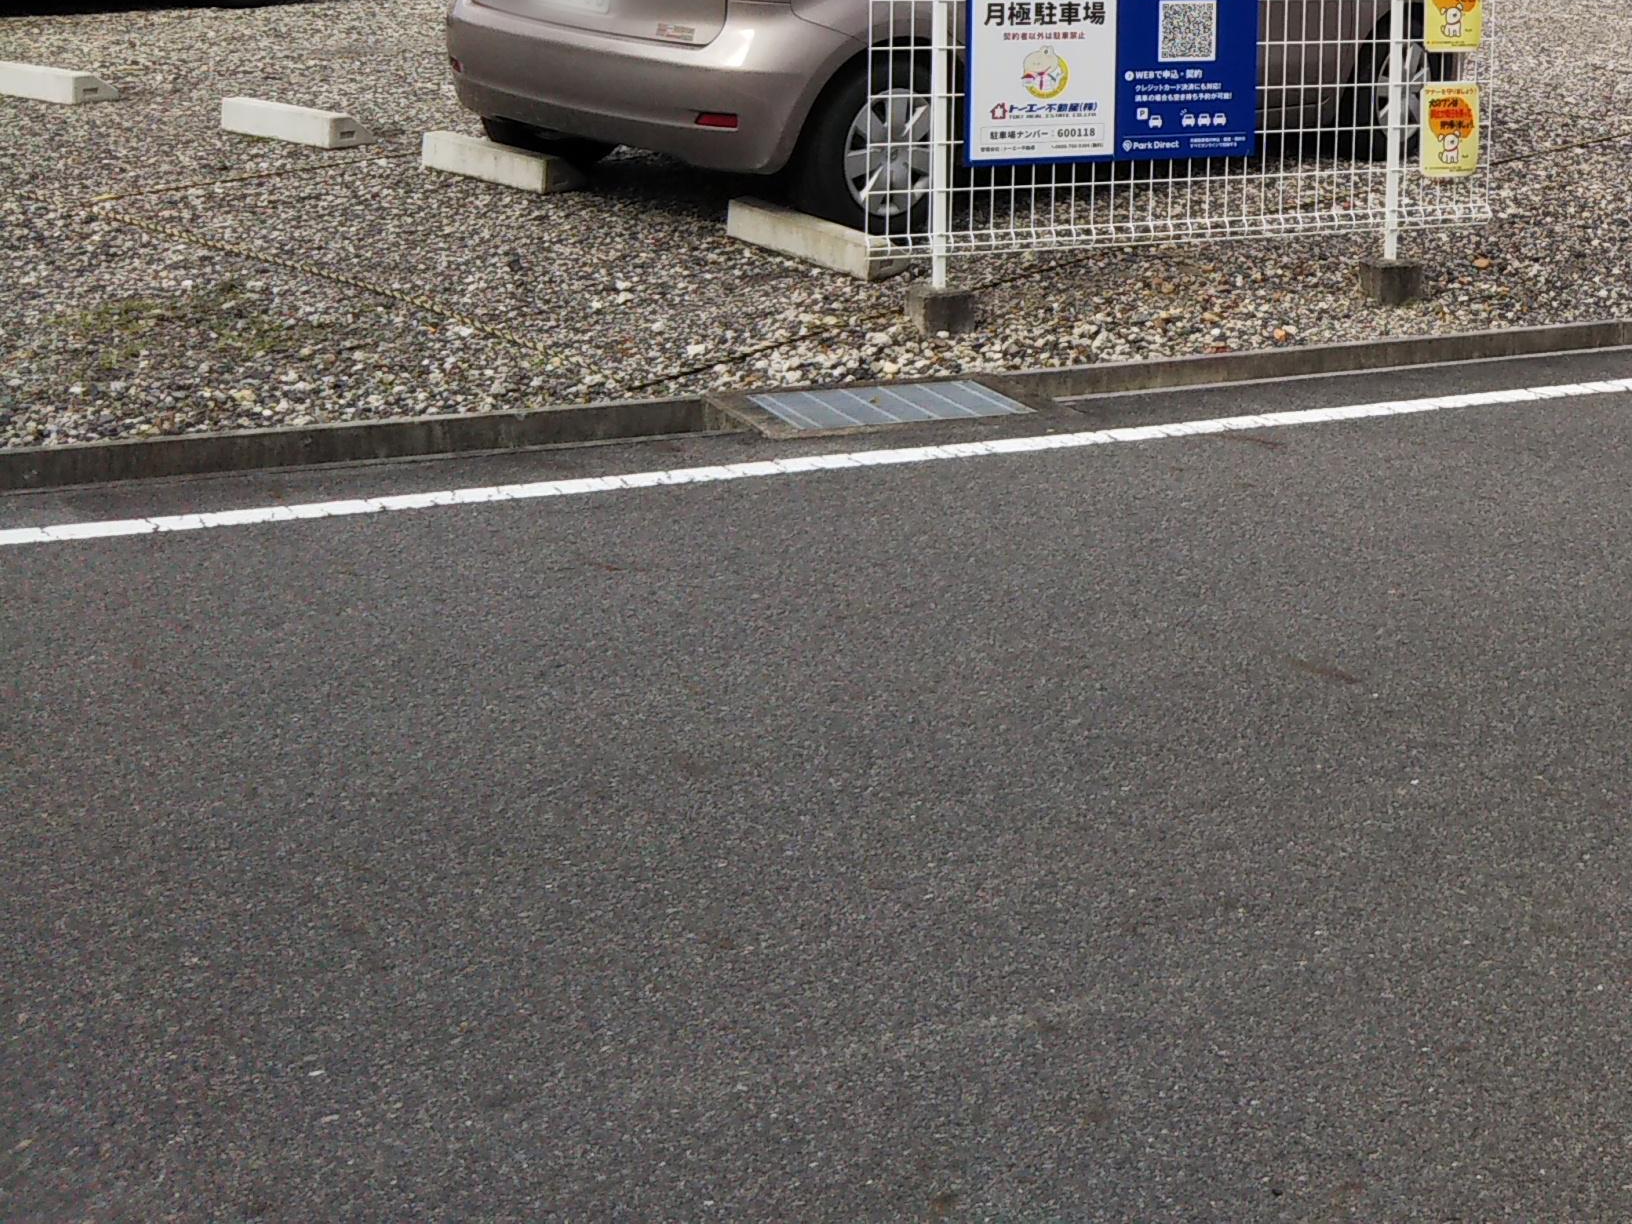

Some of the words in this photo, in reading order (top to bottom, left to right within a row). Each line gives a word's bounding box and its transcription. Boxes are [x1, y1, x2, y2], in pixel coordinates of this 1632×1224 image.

[984, 1, 1106, 26] 月極駐車場
[1003, 32, 1086, 40] 契約者以外は駐車禁止
[1133, 142, 1153, 150] Park
[1154, 140, 1180, 149] Direct
